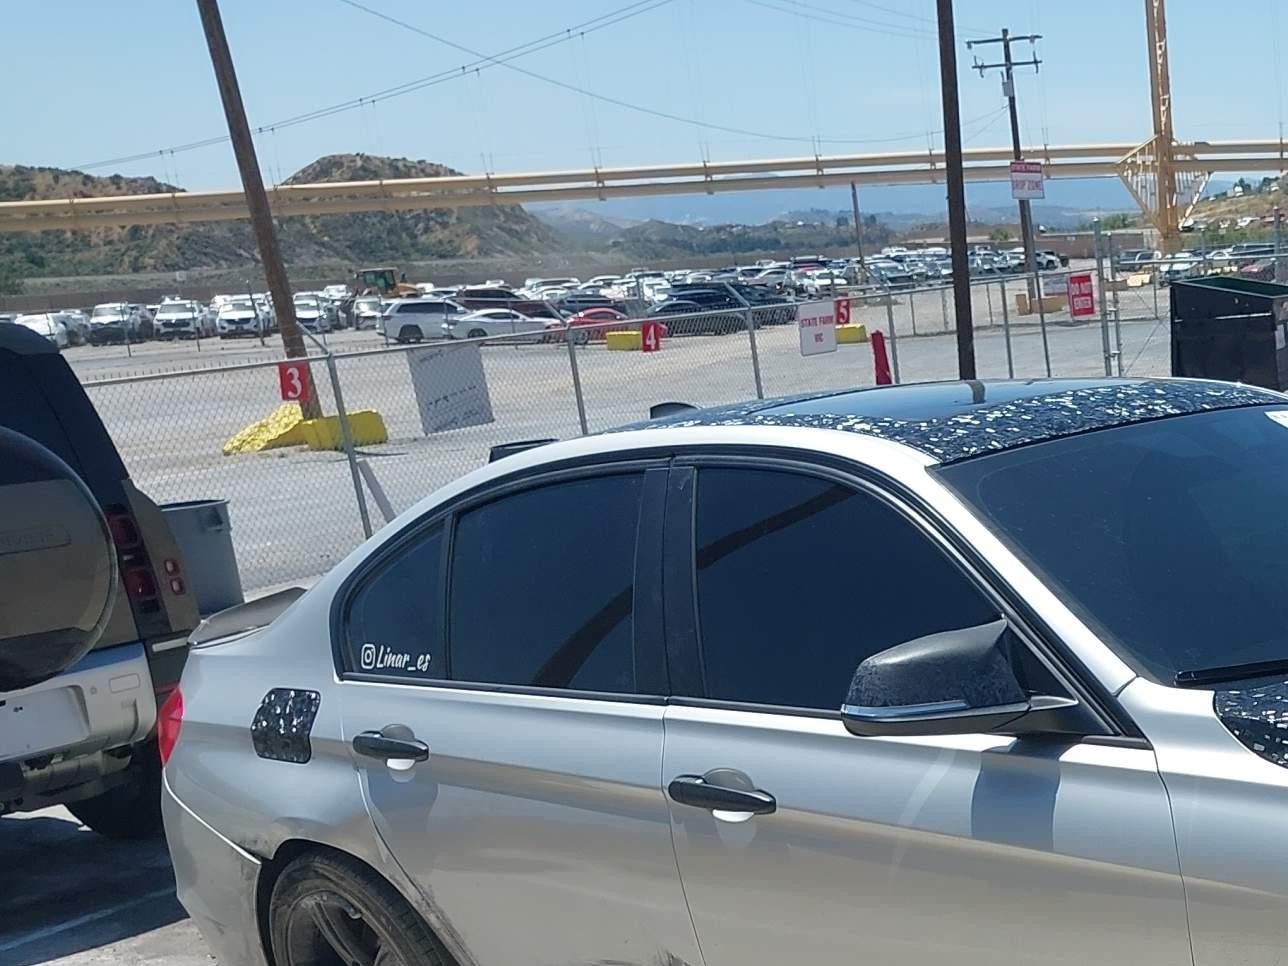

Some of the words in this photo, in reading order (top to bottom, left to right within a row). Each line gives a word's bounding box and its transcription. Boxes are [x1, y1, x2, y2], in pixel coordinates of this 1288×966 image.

[801, 317, 817, 328] STATE
[839, 300, 848, 324] 5
[646, 323, 657, 349] 4
[286, 367, 303, 398] 3
[376, 644, 431, 672] Linar_es
